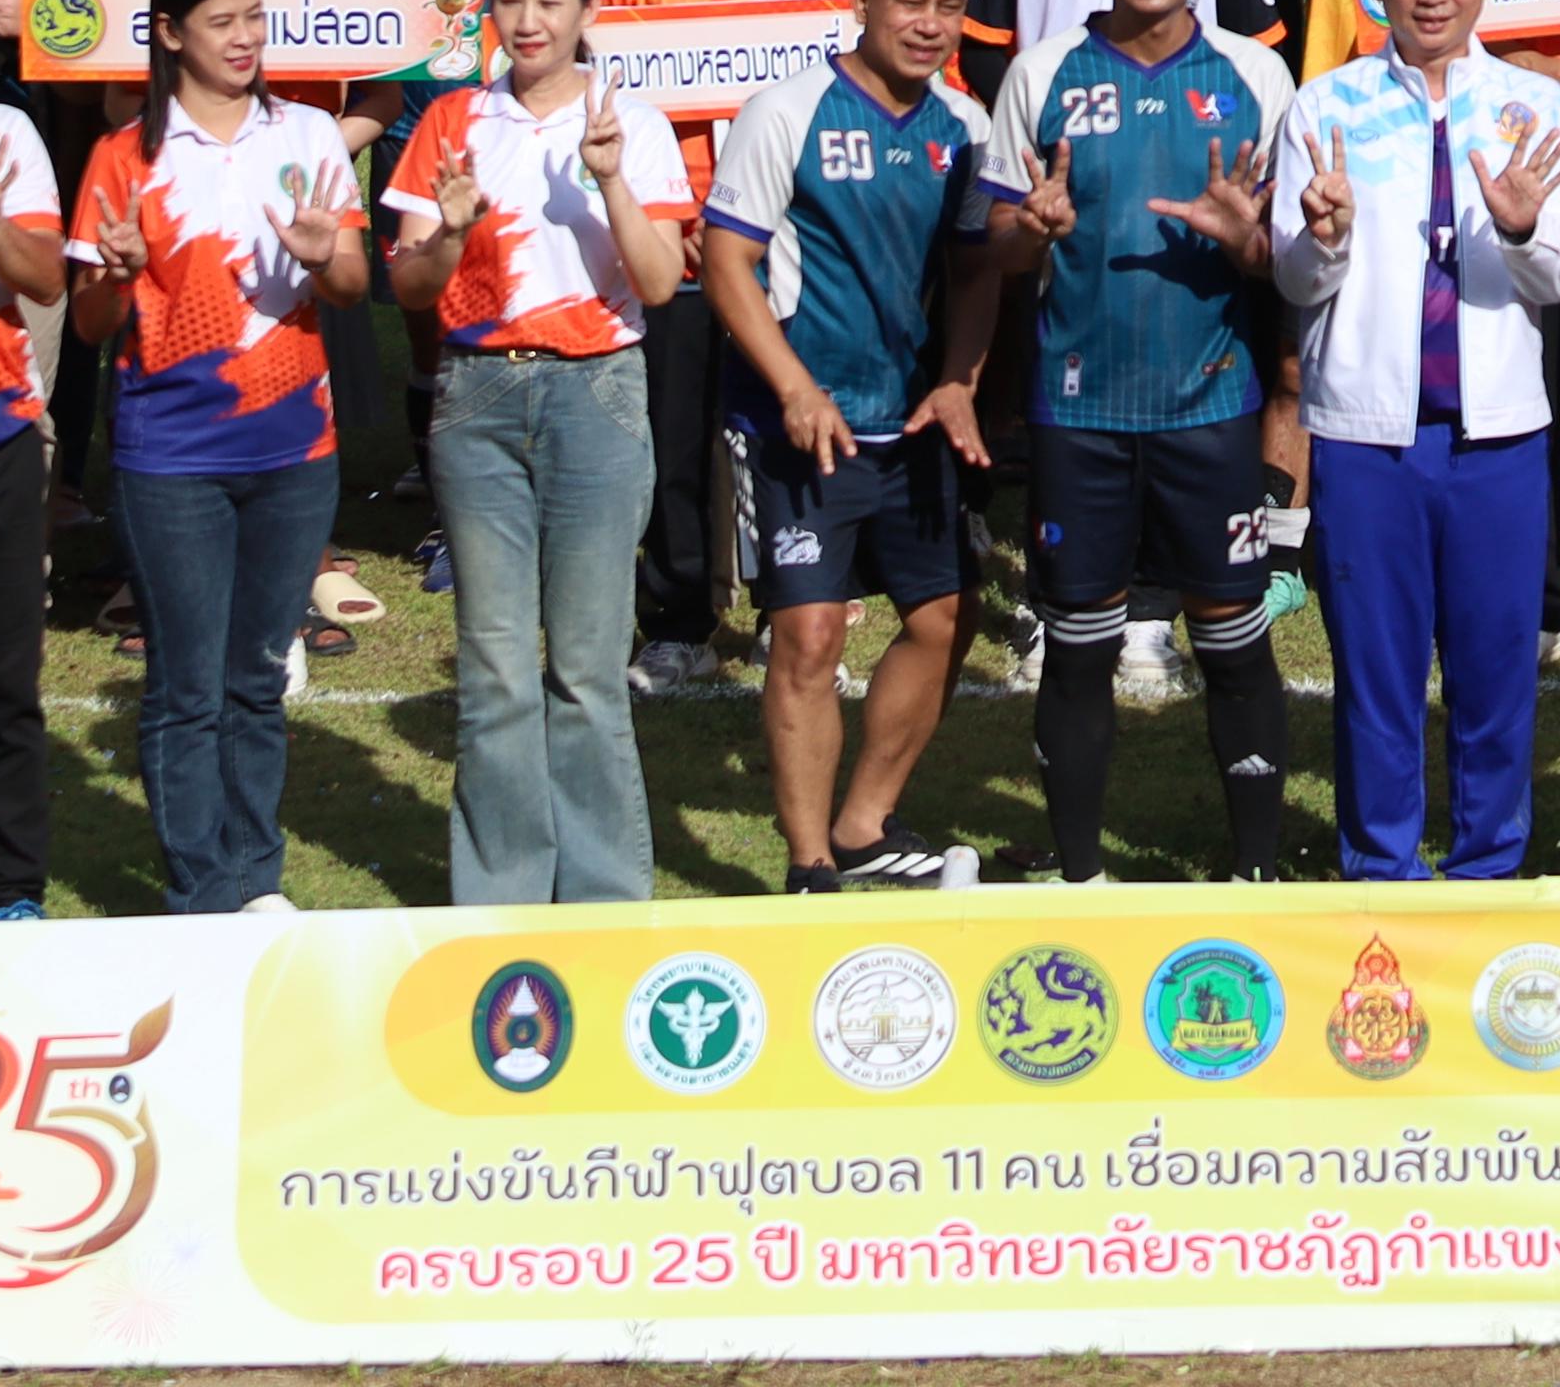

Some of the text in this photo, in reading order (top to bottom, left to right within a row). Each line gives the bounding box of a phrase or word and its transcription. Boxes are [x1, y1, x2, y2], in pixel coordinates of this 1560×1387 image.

[1061, 81, 1122, 138] 23
[818, 128, 877, 182] 50
[69, 1077, 102, 1102] th
[280, 1144, 921, 1216] การแข่งขันกีฬาฟุตบอล
[942, 1149, 983, 1192] 11
[1004, 1149, 1085, 1191] คน
[380, 1247, 631, 1290] ครบรอบ
[652, 1238, 733, 1285] 25
[754, 1227, 798, 1282] ปี
